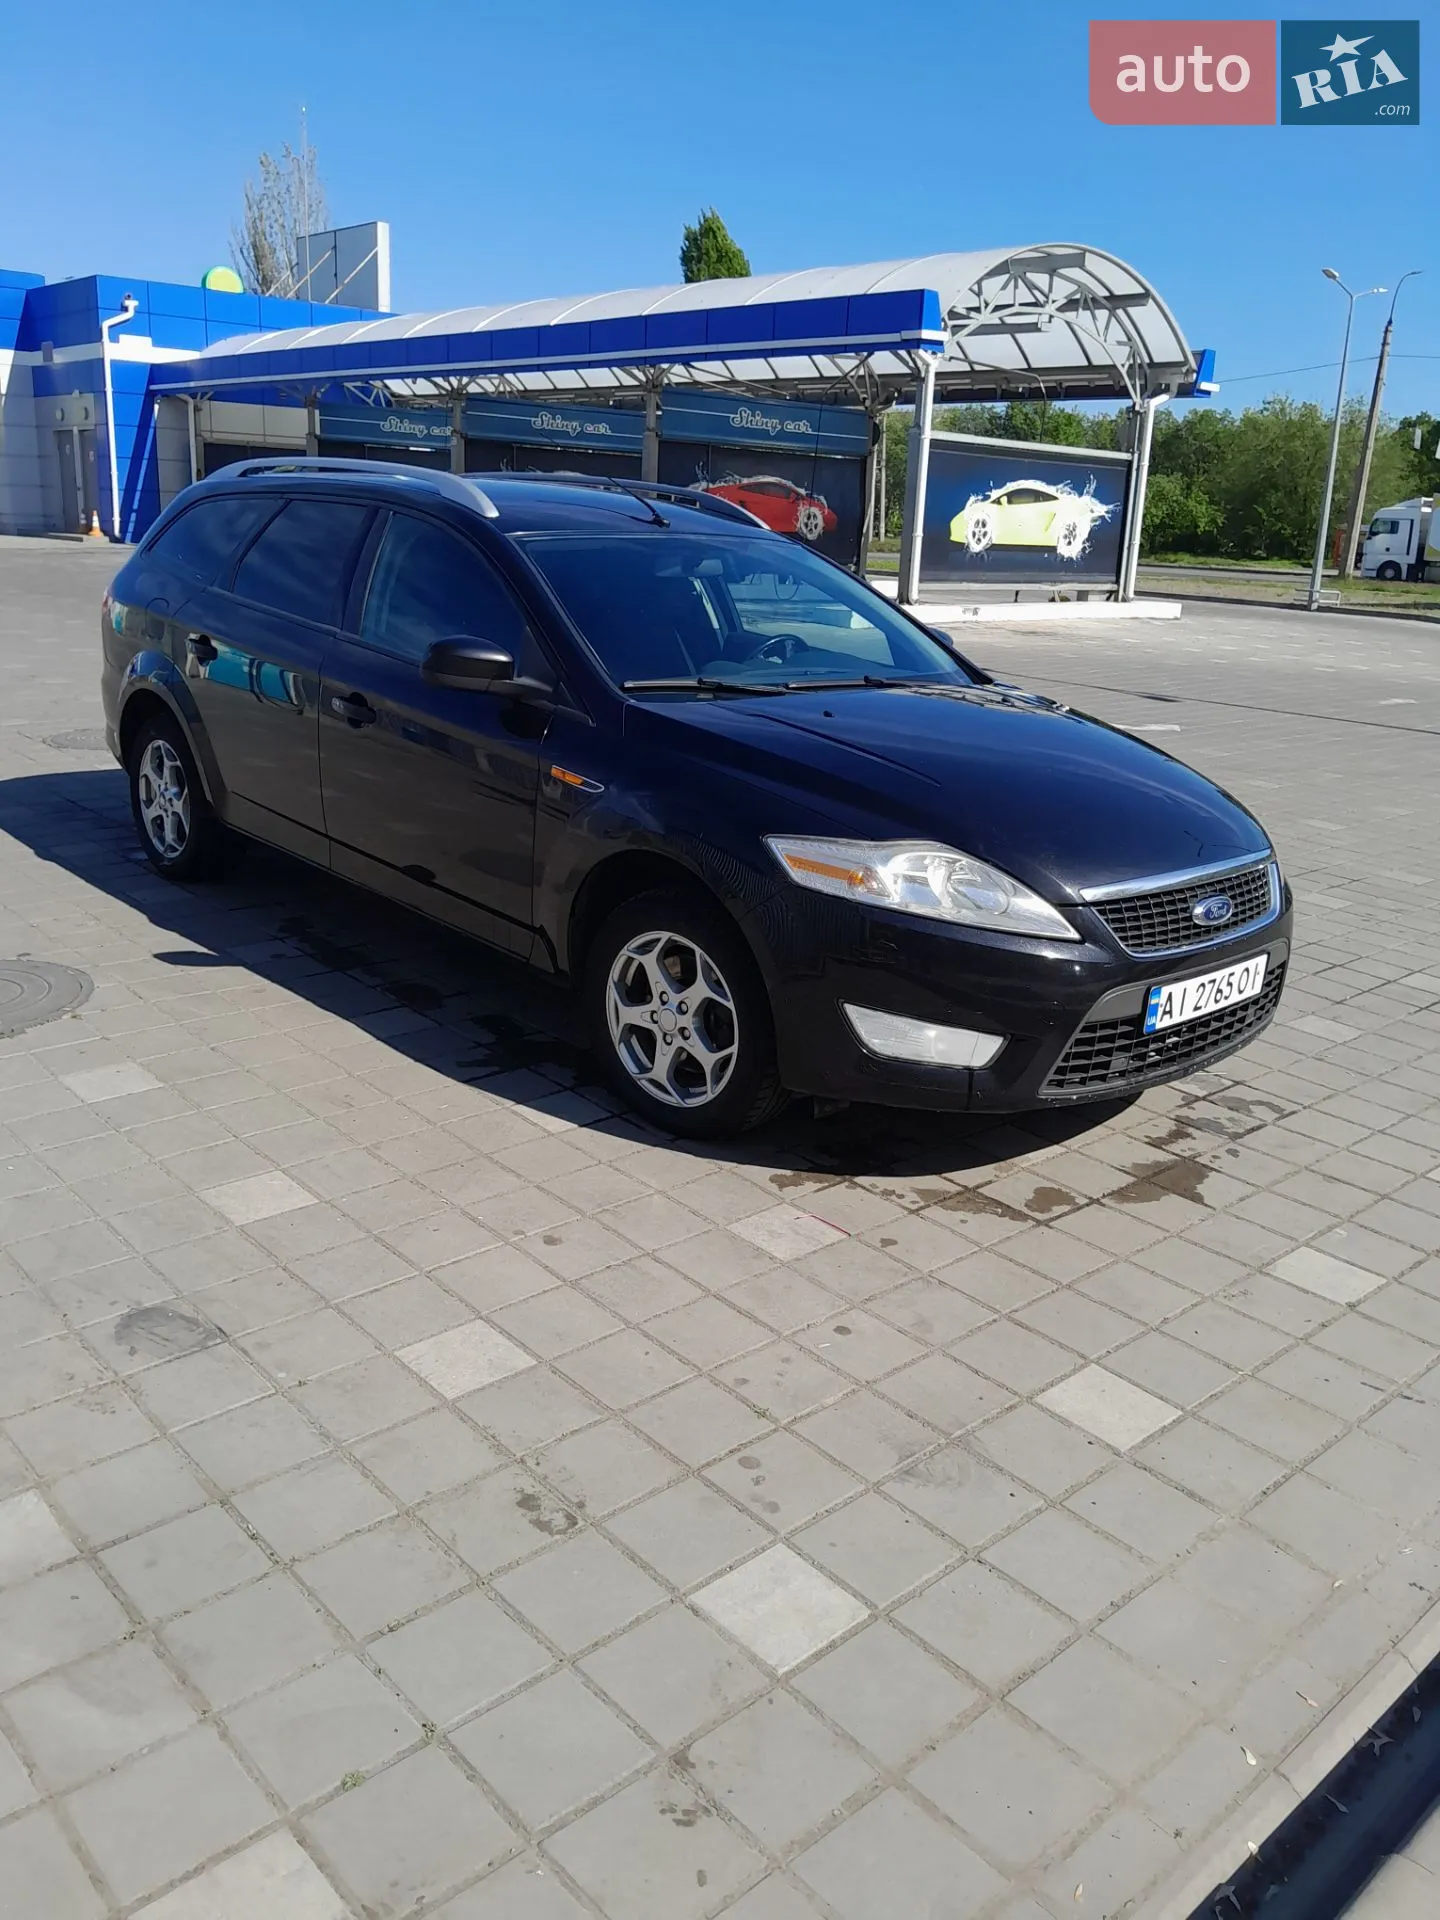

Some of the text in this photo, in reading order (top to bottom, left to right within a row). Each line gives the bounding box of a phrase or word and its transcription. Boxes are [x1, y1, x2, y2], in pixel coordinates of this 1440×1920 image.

[380, 416, 428, 438] Shiny
[531, 411, 611, 437] Shiny car
[730, 407, 812, 436] Shiny car
[1210, 903, 1227, 919] Ford
[1159, 987, 1187, 1022] AI
[1193, 971, 1235, 1012] 2765
